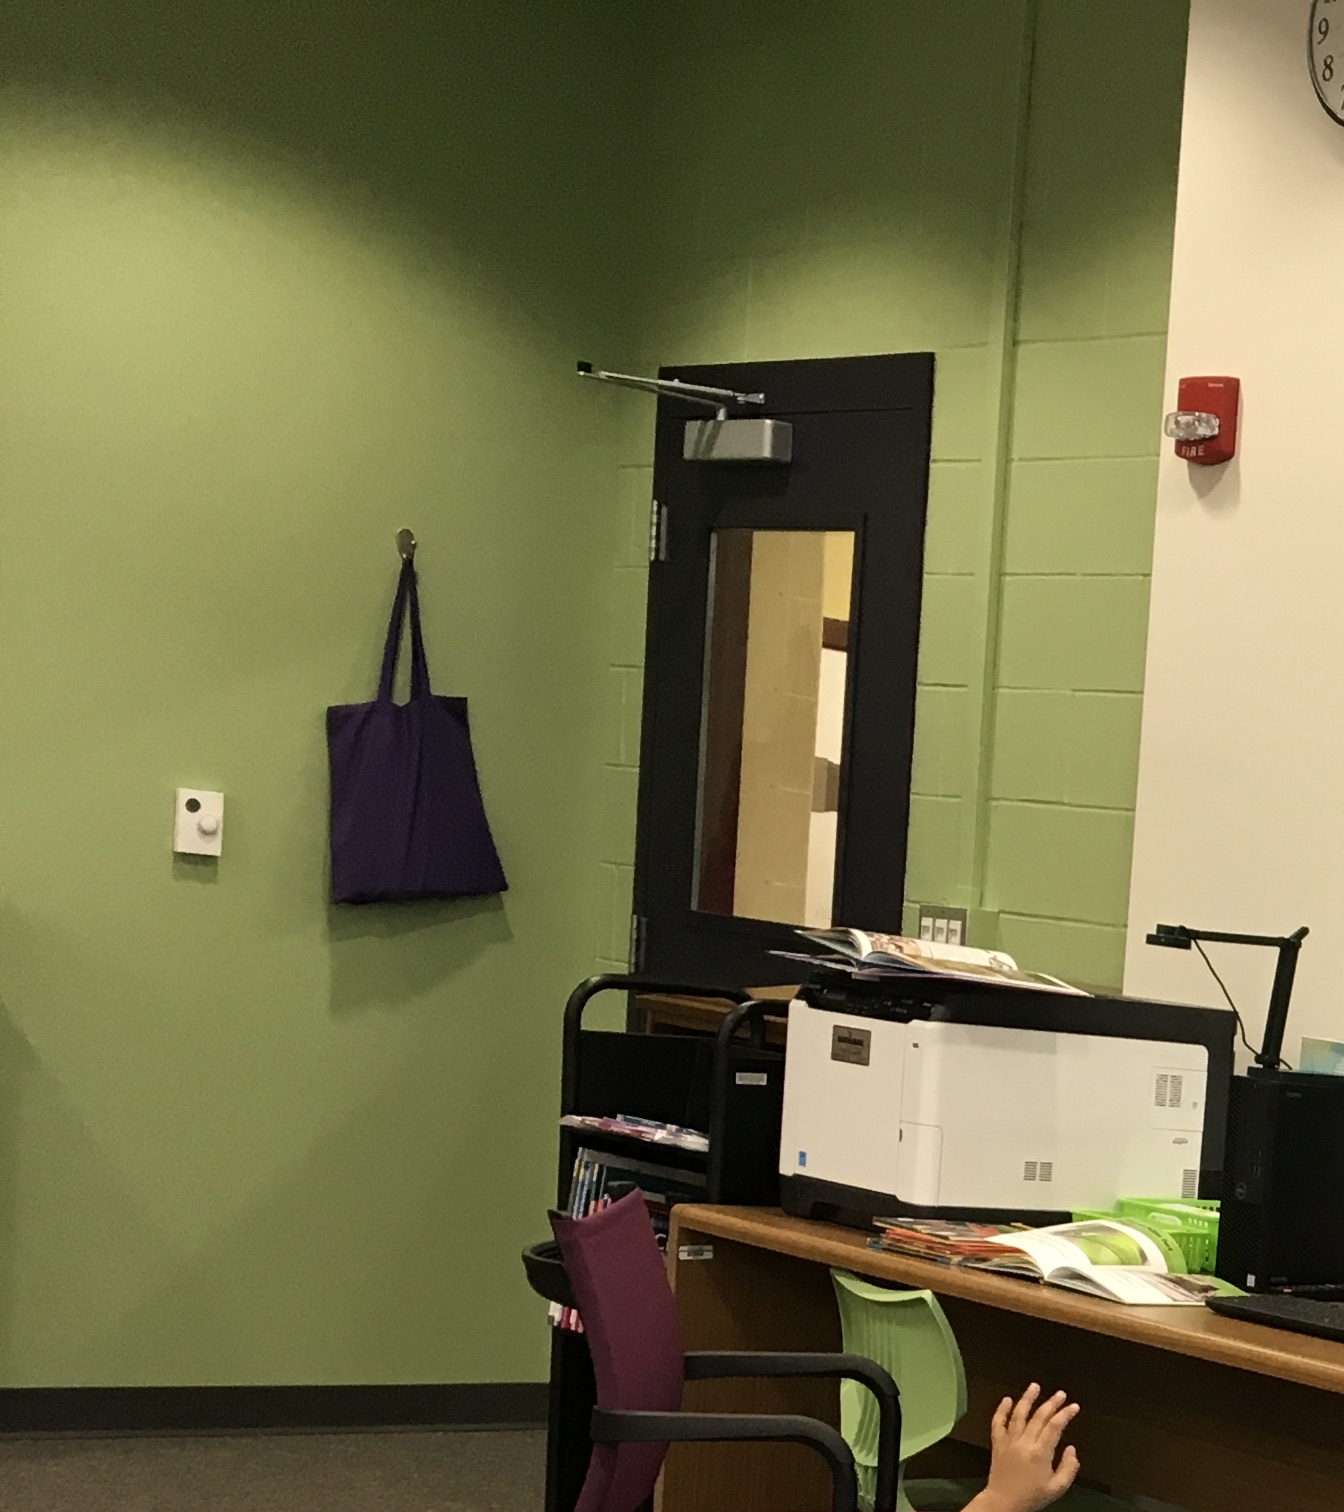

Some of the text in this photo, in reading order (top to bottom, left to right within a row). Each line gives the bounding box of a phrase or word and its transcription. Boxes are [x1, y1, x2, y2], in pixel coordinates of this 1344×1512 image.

[1316, 17, 1330, 46] 9
[1321, 54, 1334, 82] 8
[1181, 444, 1205, 458] FIRE
